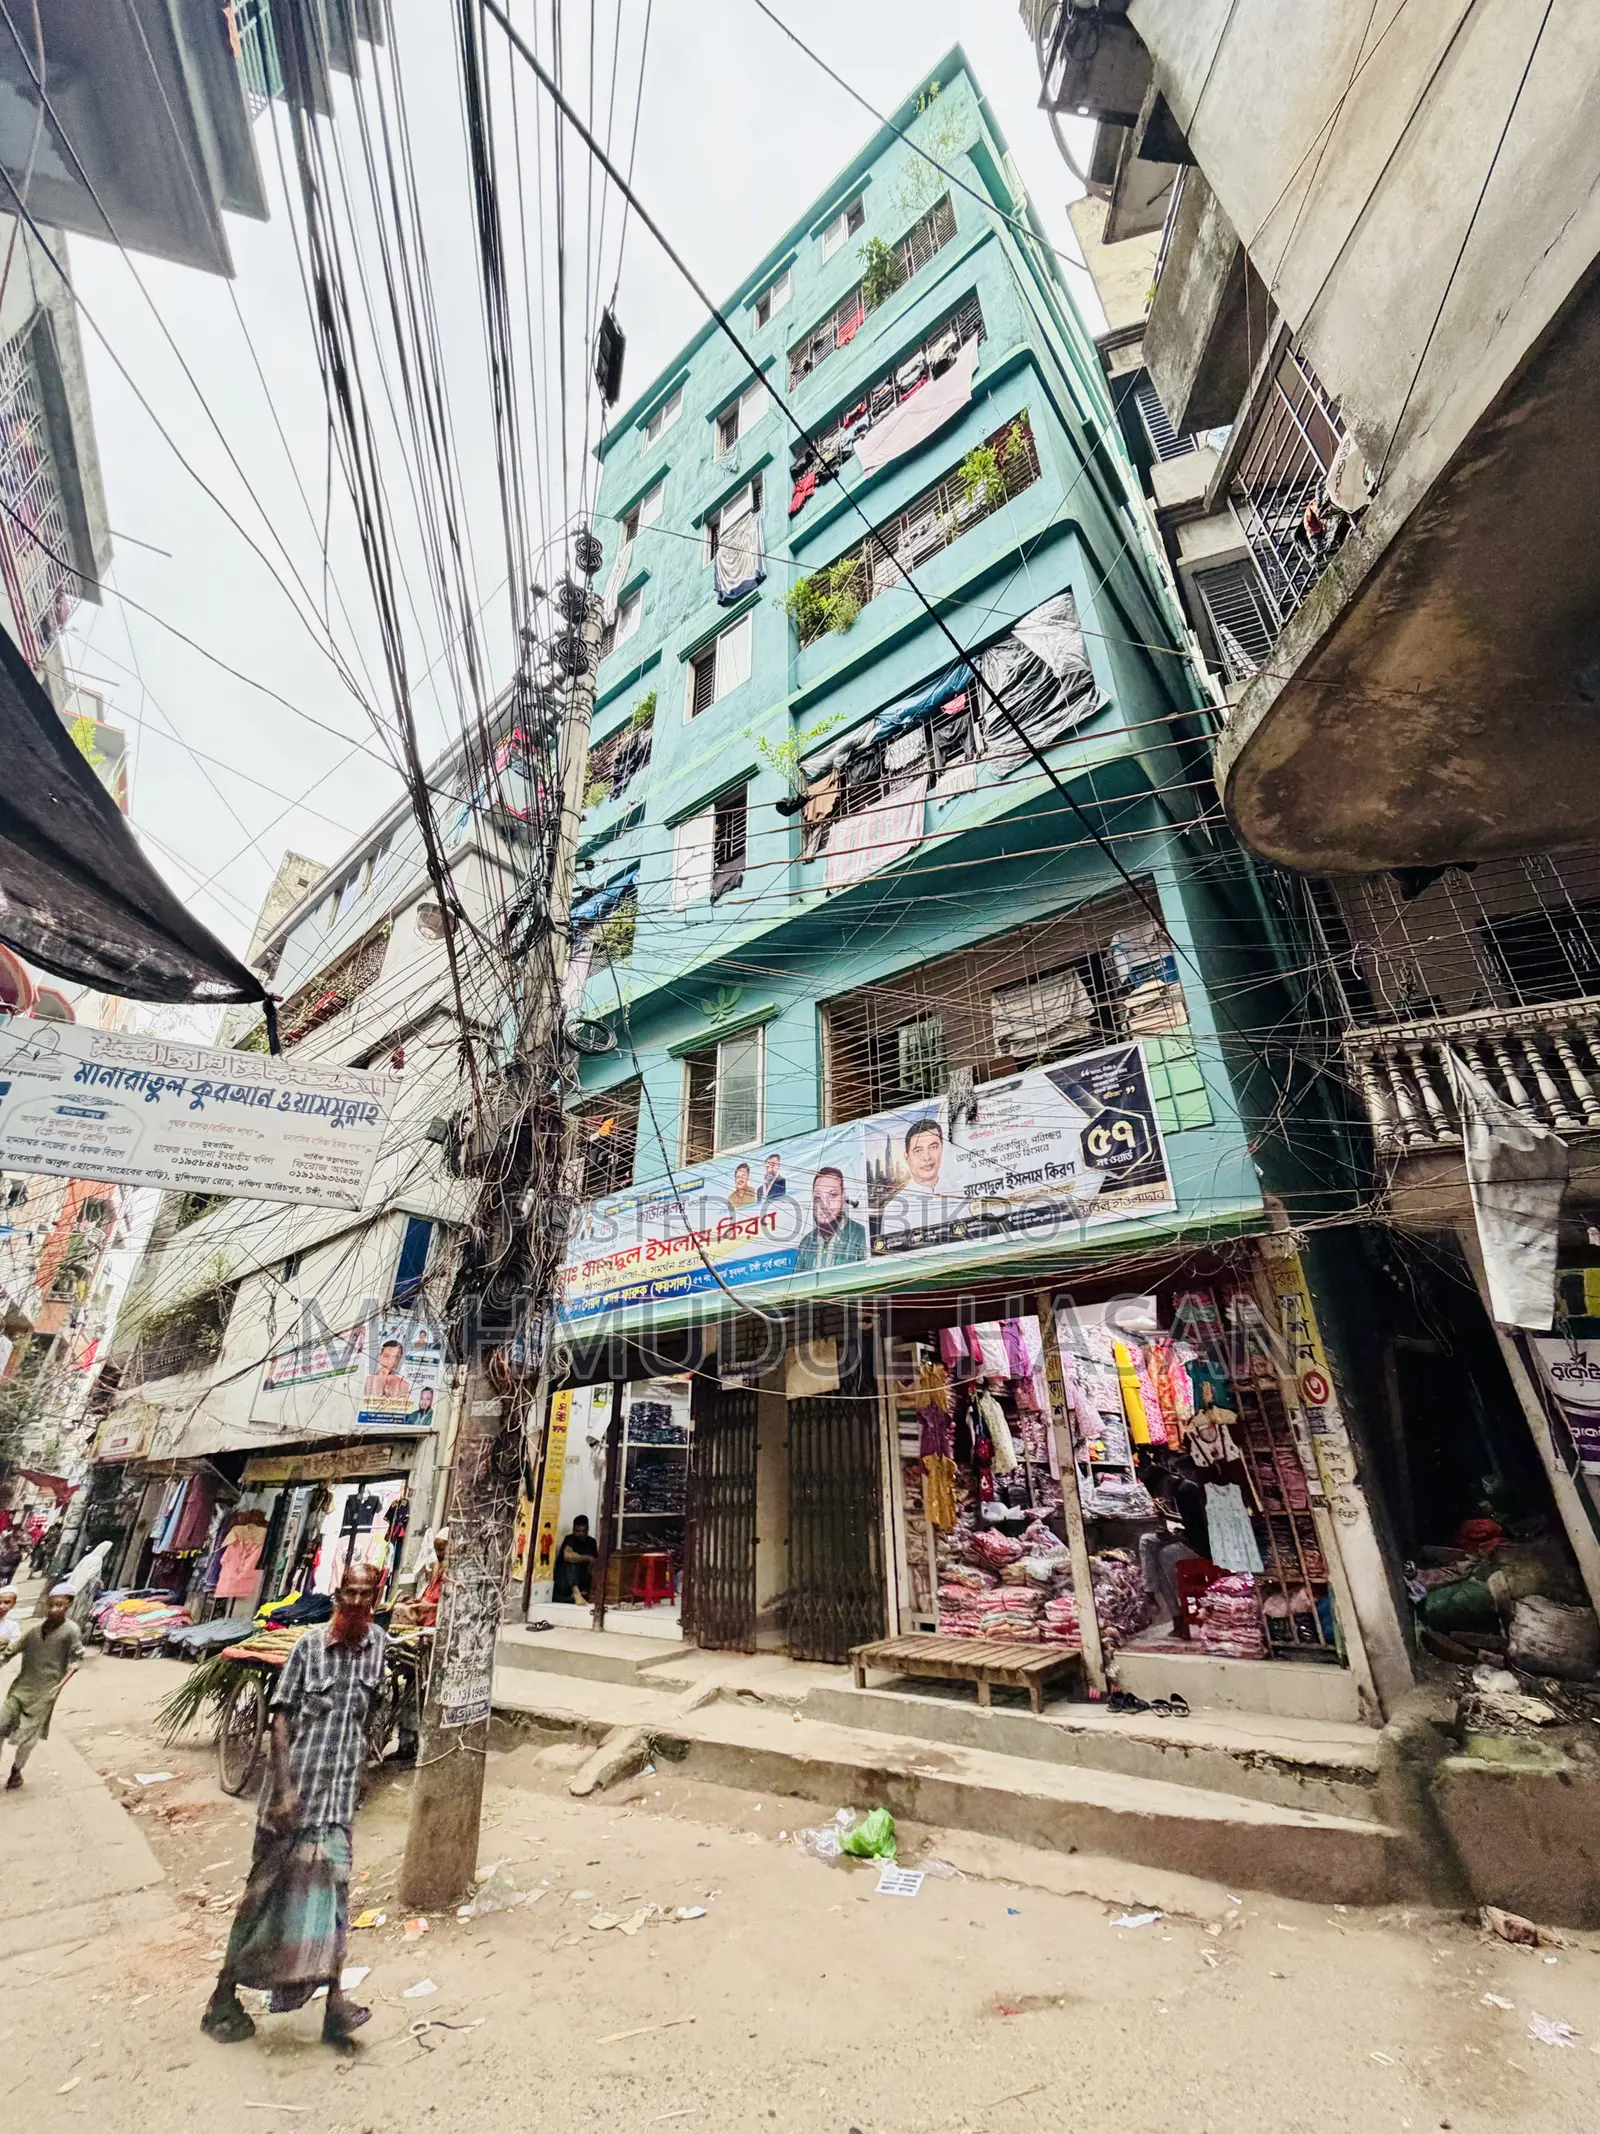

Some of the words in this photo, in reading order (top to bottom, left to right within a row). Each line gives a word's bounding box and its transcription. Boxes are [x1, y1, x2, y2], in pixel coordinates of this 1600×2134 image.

[74, 1061, 189, 1104] মানারাতুল
[189, 1078, 276, 1111] কুরআন
[1023, 1144, 1050, 1158] হিসেবে
[1088, 1120, 1136, 1156] ৫৭
[46, 1157, 69, 1168] আবুল
[73, 1161, 103, 1171] হোসেন
[106, 1166, 142, 1176] সাহেবের
[292, 1158, 328, 1172] ফিরোজ
[1109, 1150, 1134, 1164] ওয়ার্ড
[964, 1178, 1005, 1198] রাশেদুল
[1005, 1168, 1043, 1190] ইসলাম
[1045, 1161, 1075, 1180] কিরণ
[645, 1228, 712, 1262] ইসলাম
[716, 1211, 777, 1245] কিরণ
